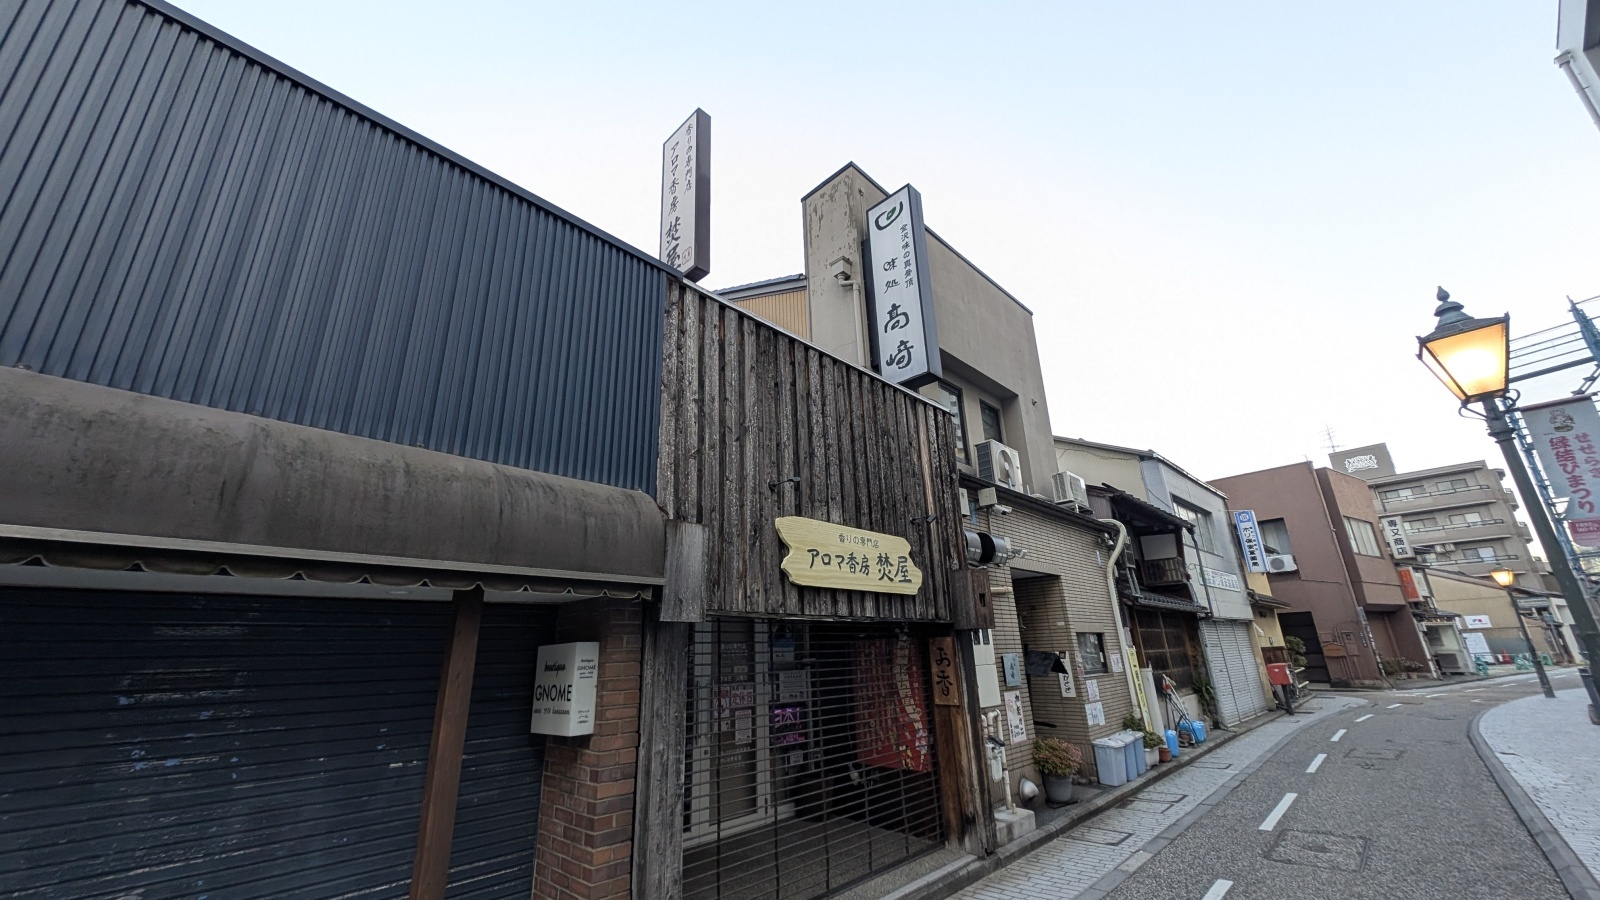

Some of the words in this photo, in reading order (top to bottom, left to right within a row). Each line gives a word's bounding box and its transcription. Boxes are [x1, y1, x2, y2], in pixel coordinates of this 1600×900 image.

[900, 223, 914, 289] 金沢味の真骨頂
[1548, 434, 1595, 514] 縁結びまつり
[838, 533, 880, 549] 香りの専門店
[807, 548, 870, 576] アロマ香房
[935, 647, 953, 697] お香
[535, 684, 572, 702] GNOME
